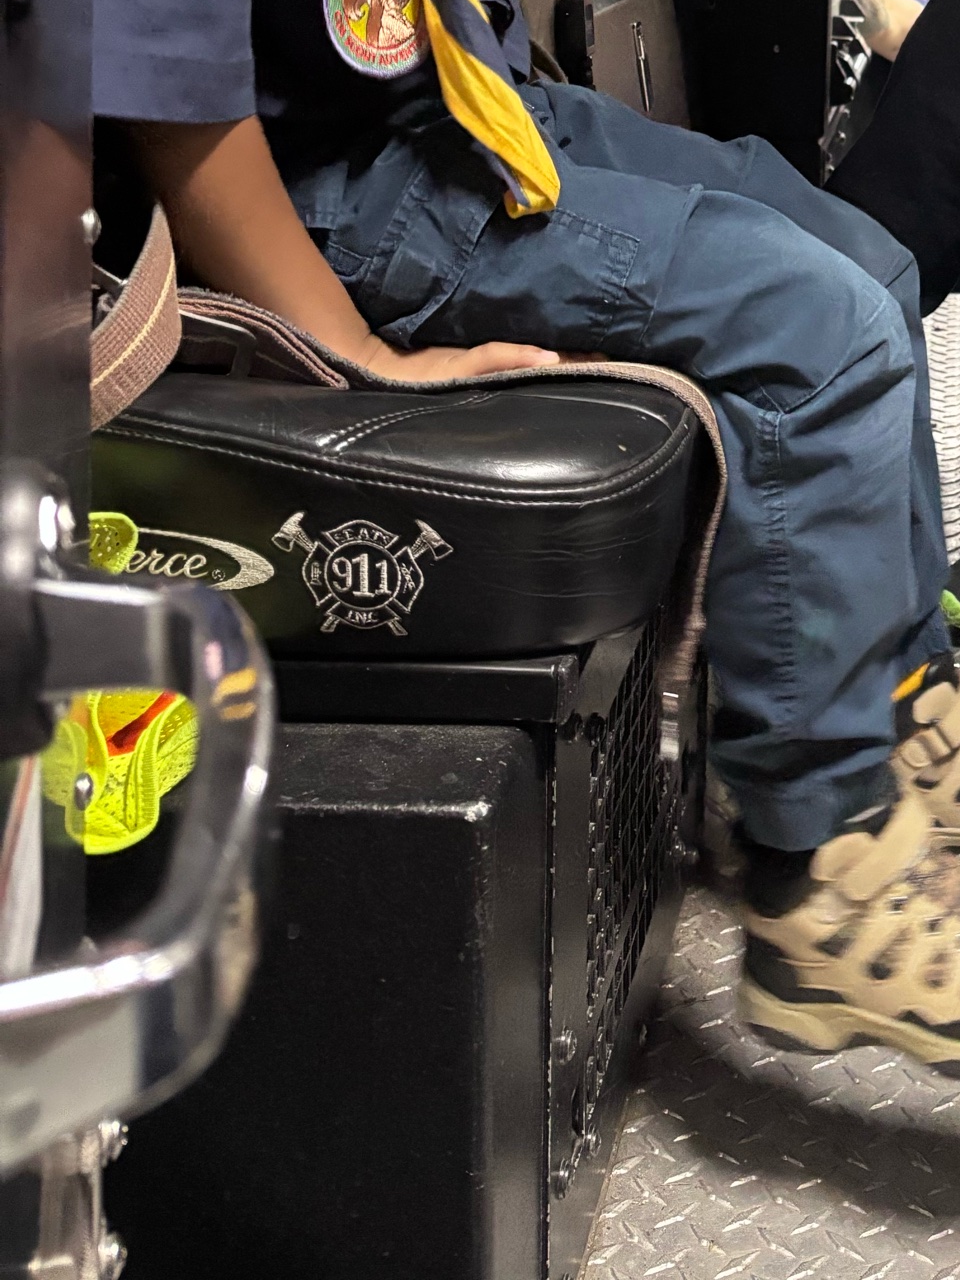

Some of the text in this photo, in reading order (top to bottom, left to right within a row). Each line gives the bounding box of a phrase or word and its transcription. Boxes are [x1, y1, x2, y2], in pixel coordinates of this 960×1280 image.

[333, 527, 392, 549] SEATS
[124, 548, 208, 579] erce
[331, 553, 392, 598] 911
